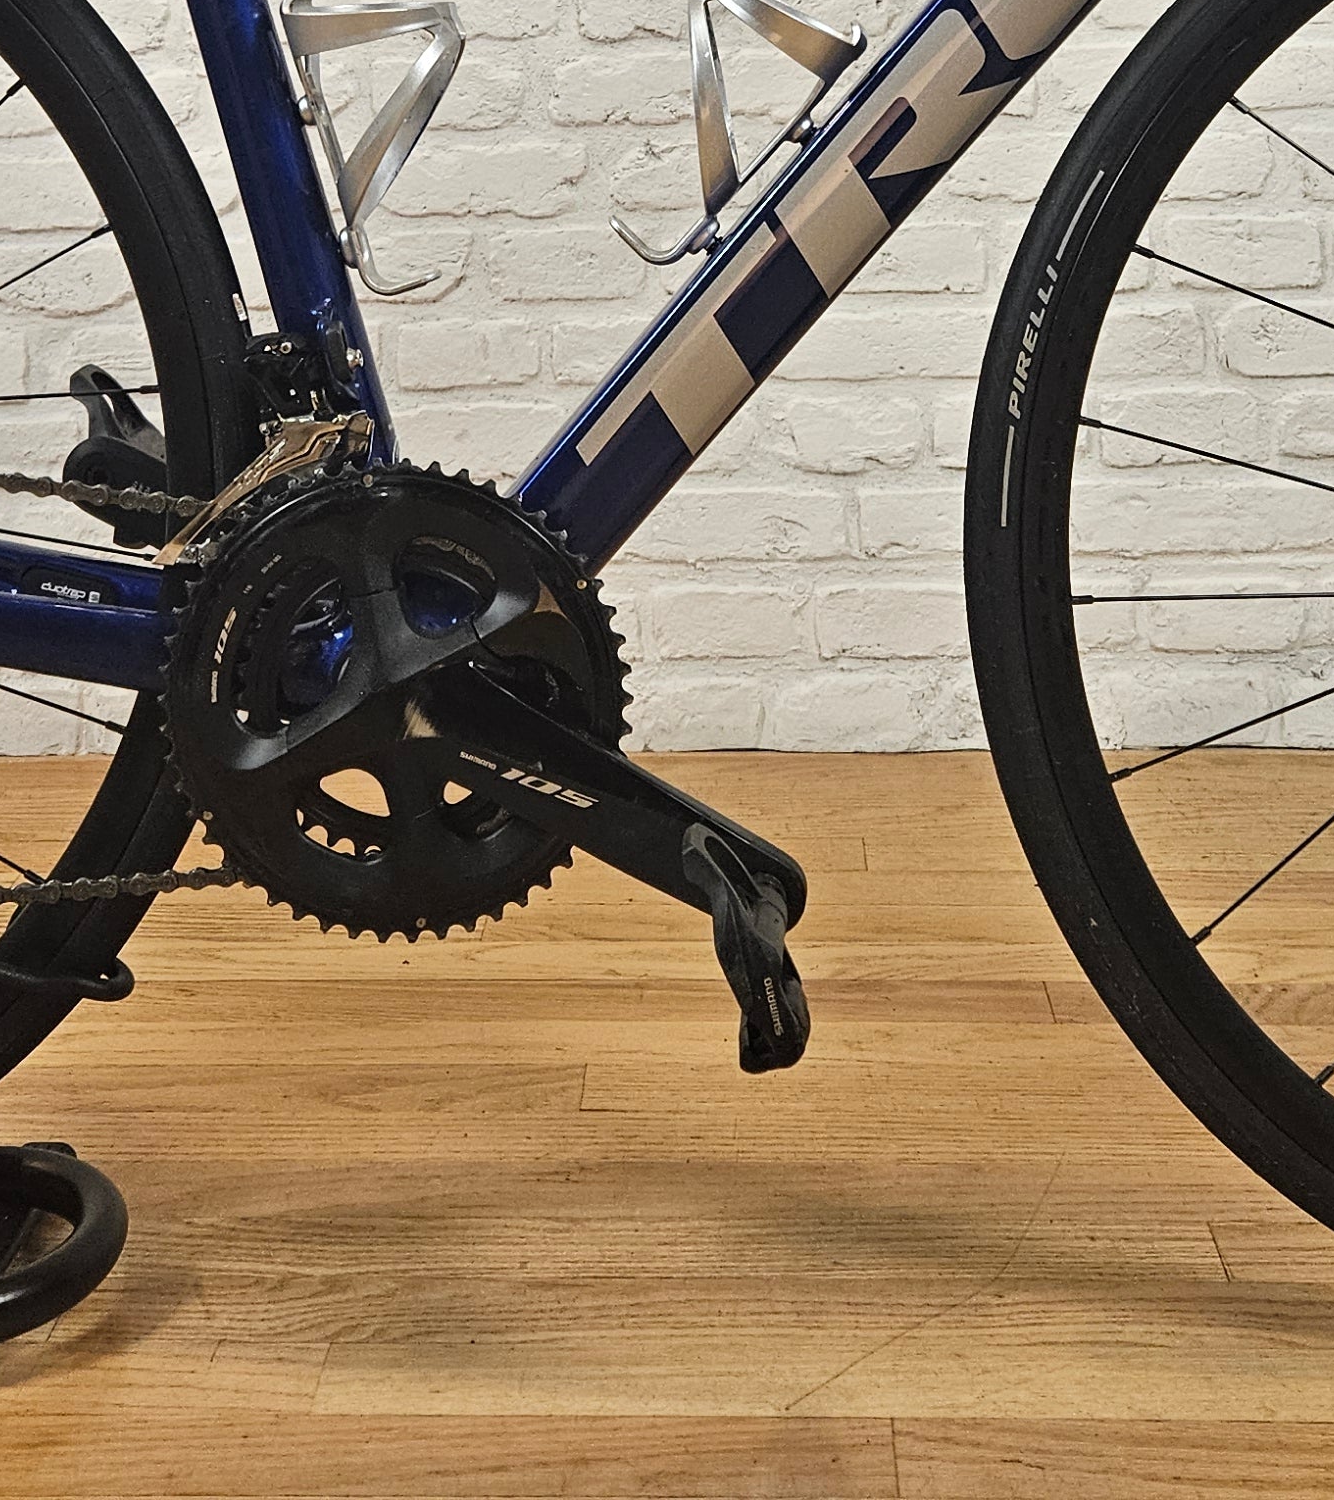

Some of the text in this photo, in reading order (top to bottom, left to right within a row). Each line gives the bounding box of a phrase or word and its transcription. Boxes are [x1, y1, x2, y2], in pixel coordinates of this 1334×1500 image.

[1008, 265, 1058, 420] PIRELLI
[213, 606, 238, 665] 105
[500, 767, 599, 809] 105
[764, 977, 785, 1037] SHIMANO
